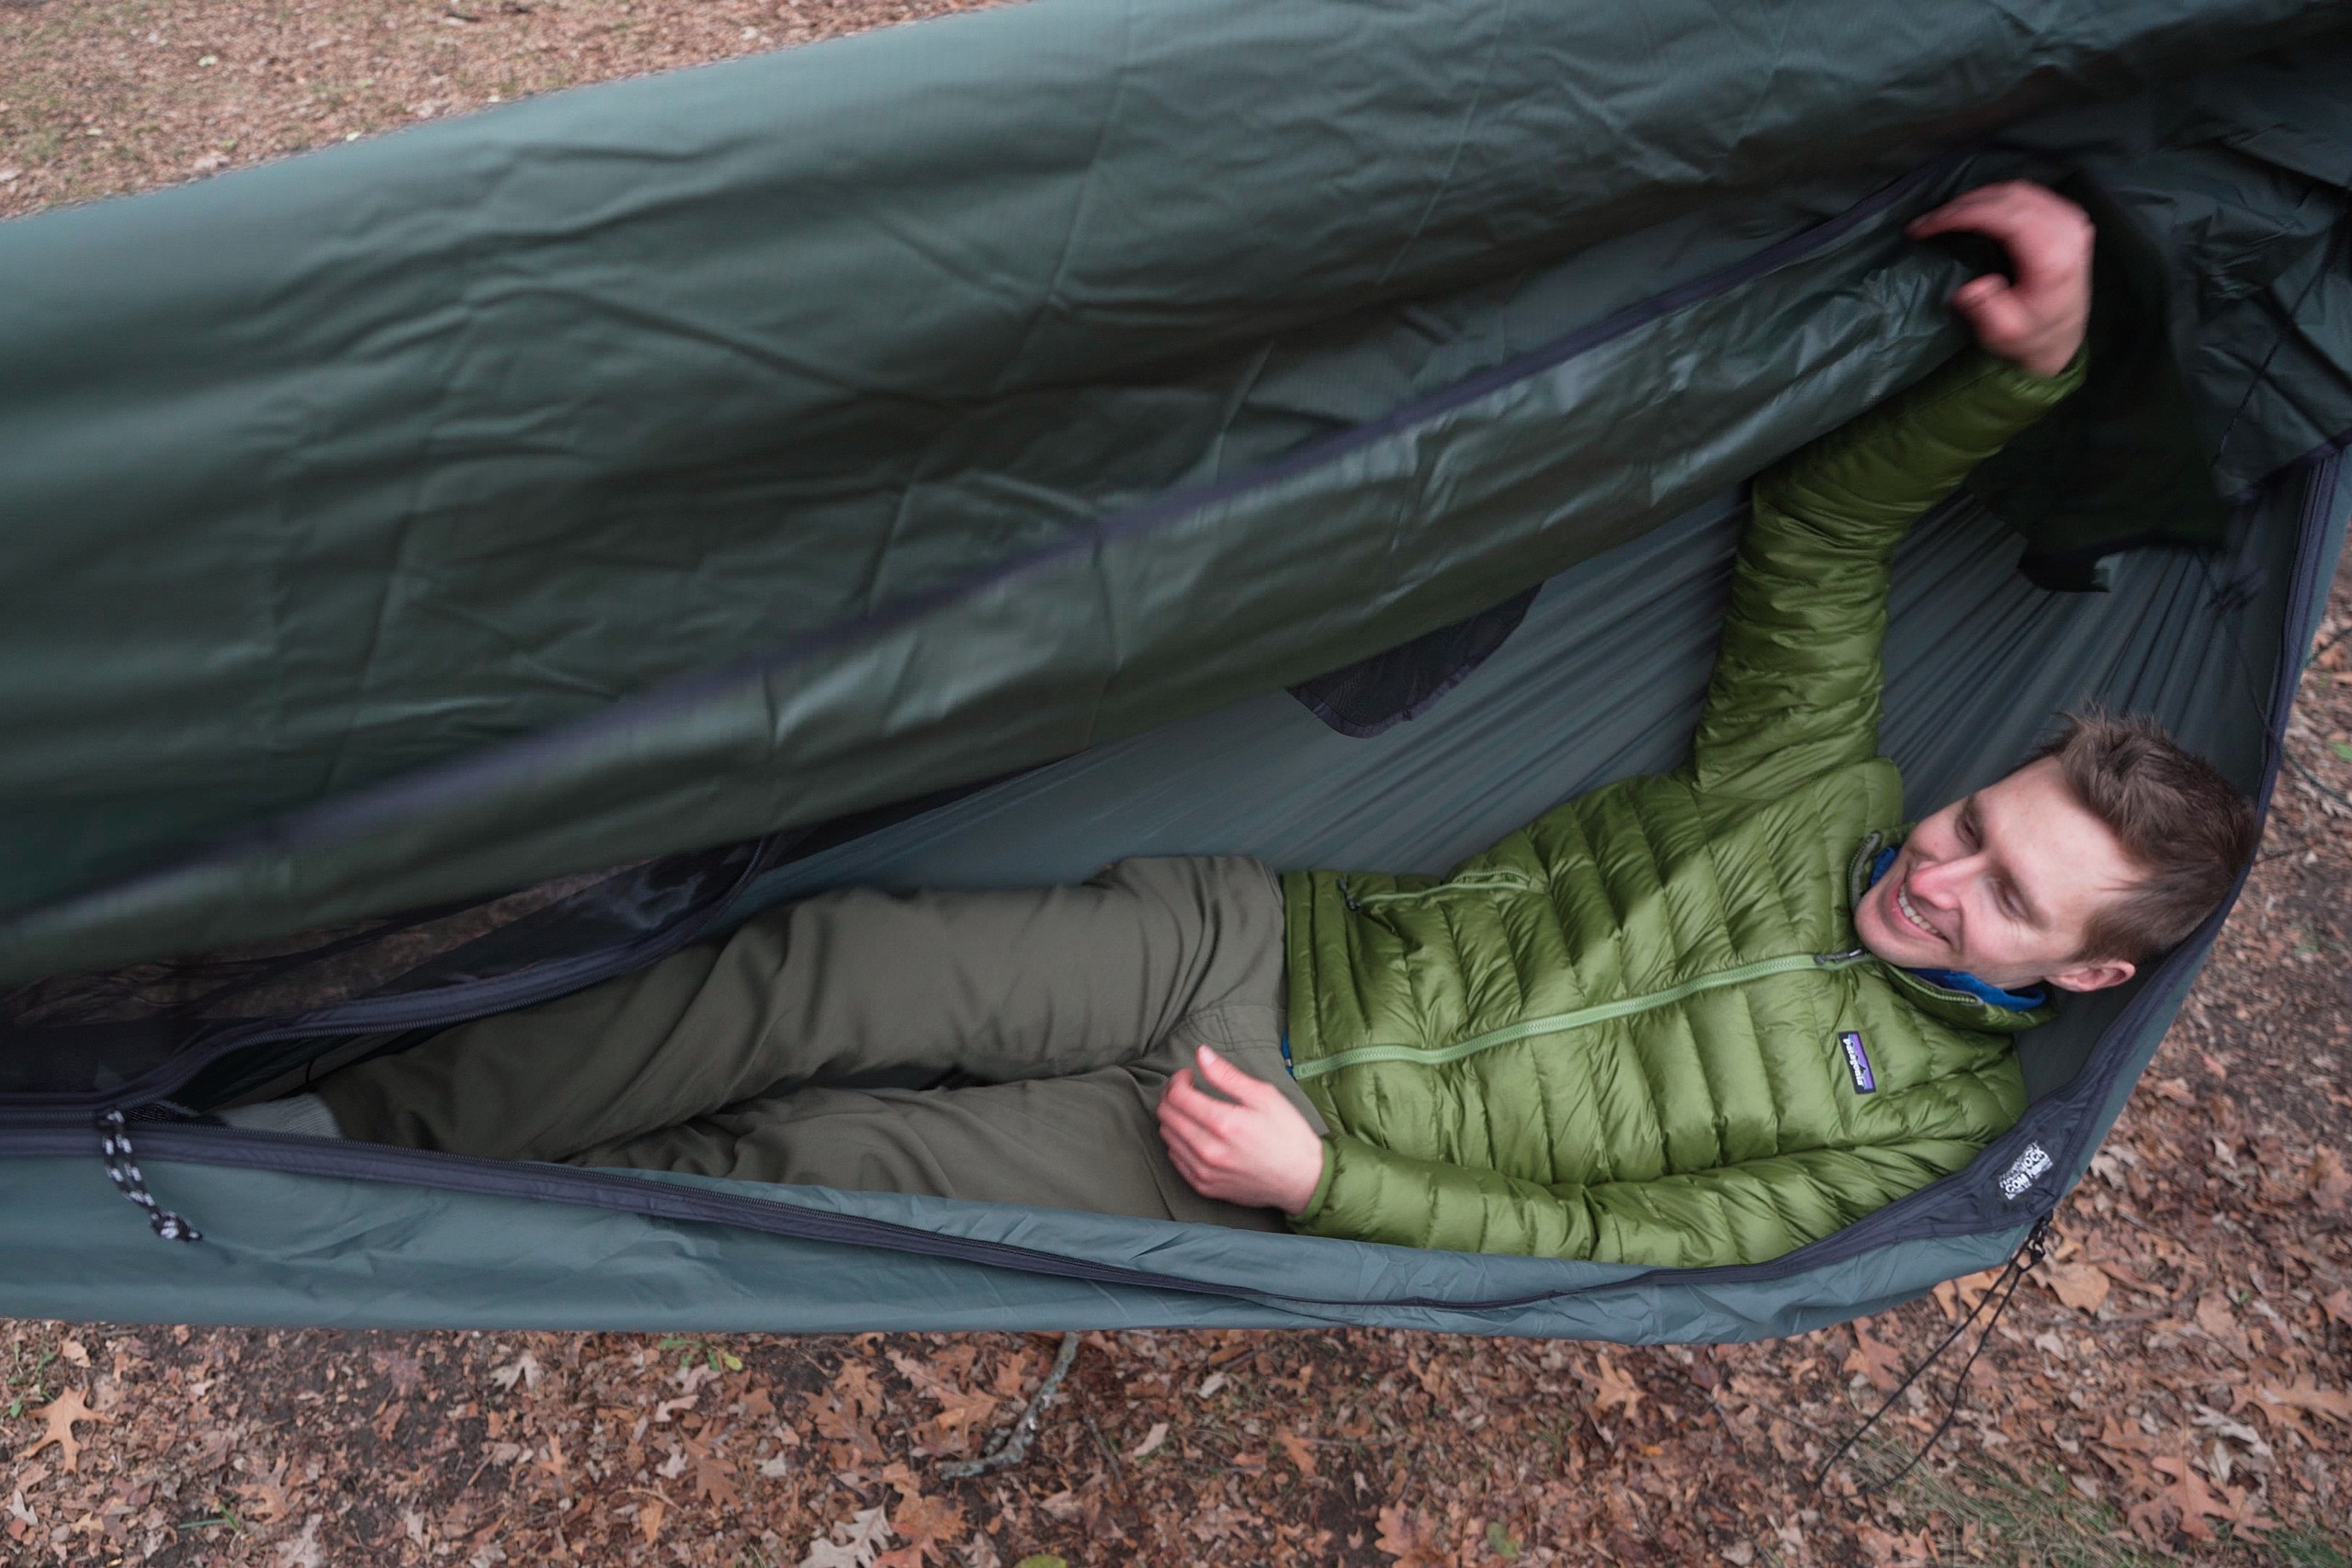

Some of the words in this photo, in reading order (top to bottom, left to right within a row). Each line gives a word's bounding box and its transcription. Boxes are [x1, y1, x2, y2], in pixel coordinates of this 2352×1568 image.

[1842, 1038, 1864, 1086] patagonia
[1999, 1148, 2046, 1189] HAOCK
[2005, 1154, 2051, 1193] COMP
